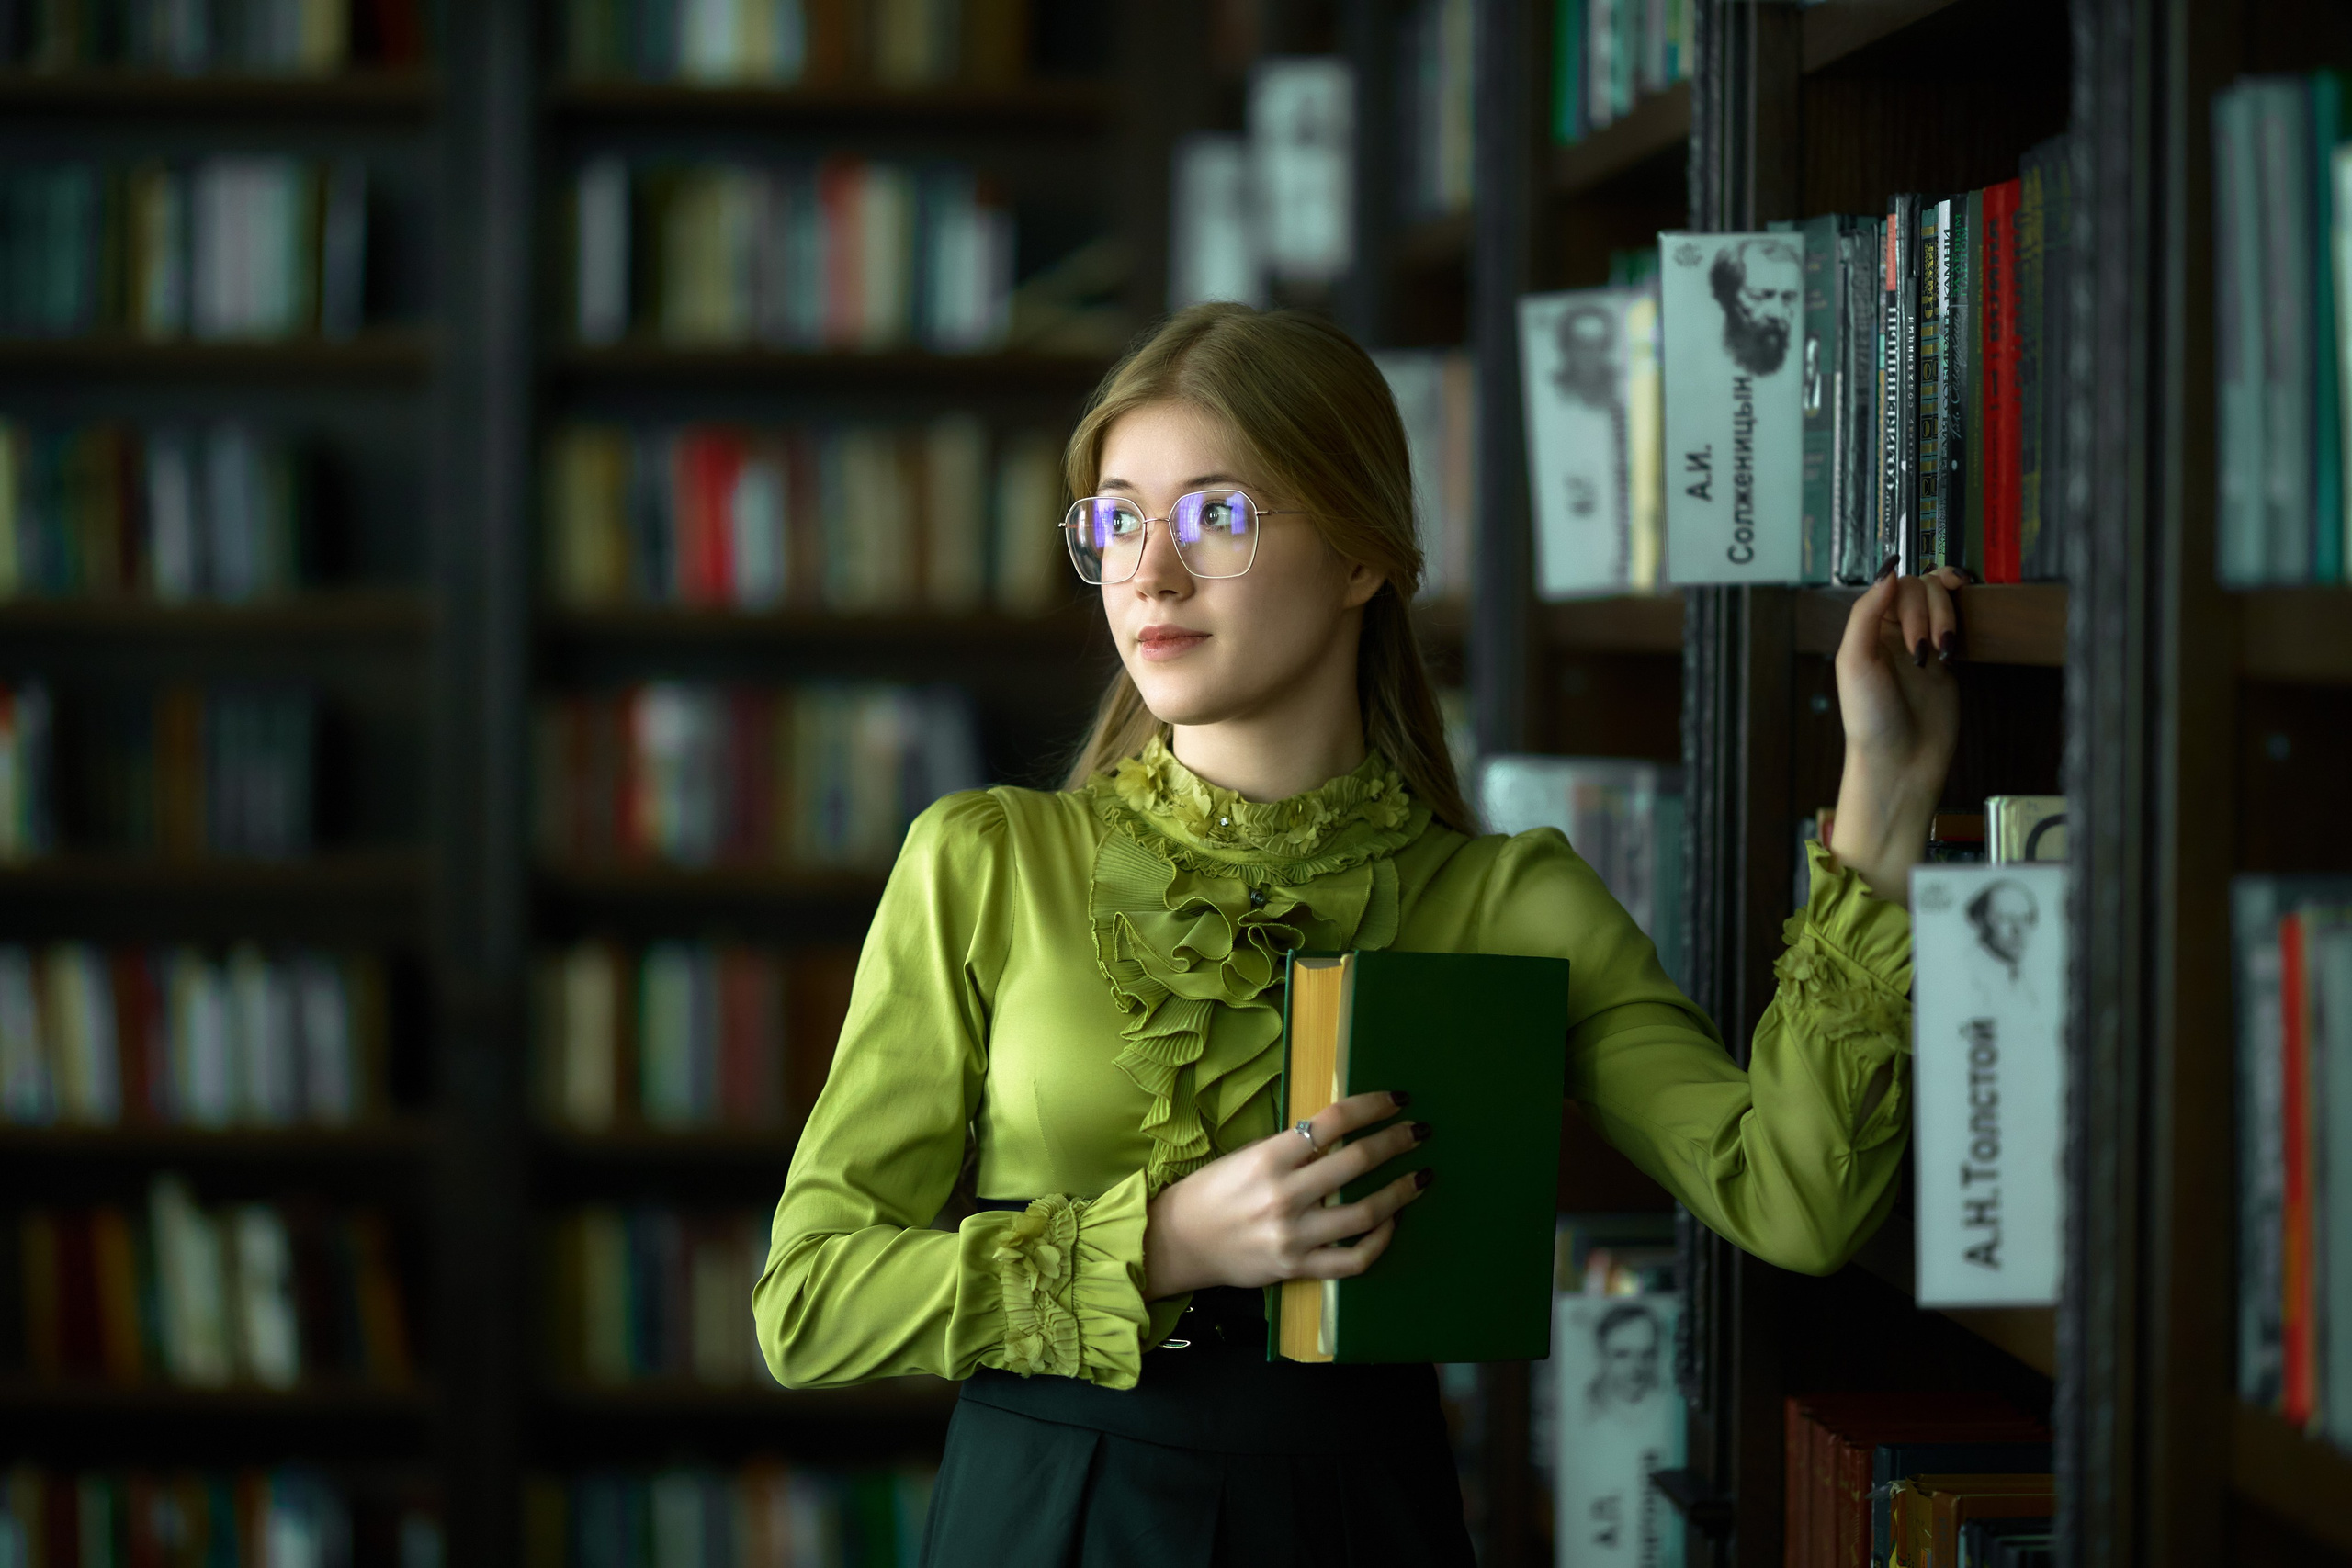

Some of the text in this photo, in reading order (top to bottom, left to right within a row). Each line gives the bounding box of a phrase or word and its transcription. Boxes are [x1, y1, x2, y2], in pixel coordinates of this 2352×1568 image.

[1685, 443, 1712, 502] А.И.
[1727, 375, 1758, 565] Солженицын
[1886, 307, 1898, 490] СОЛЖЕНИЦЫН
